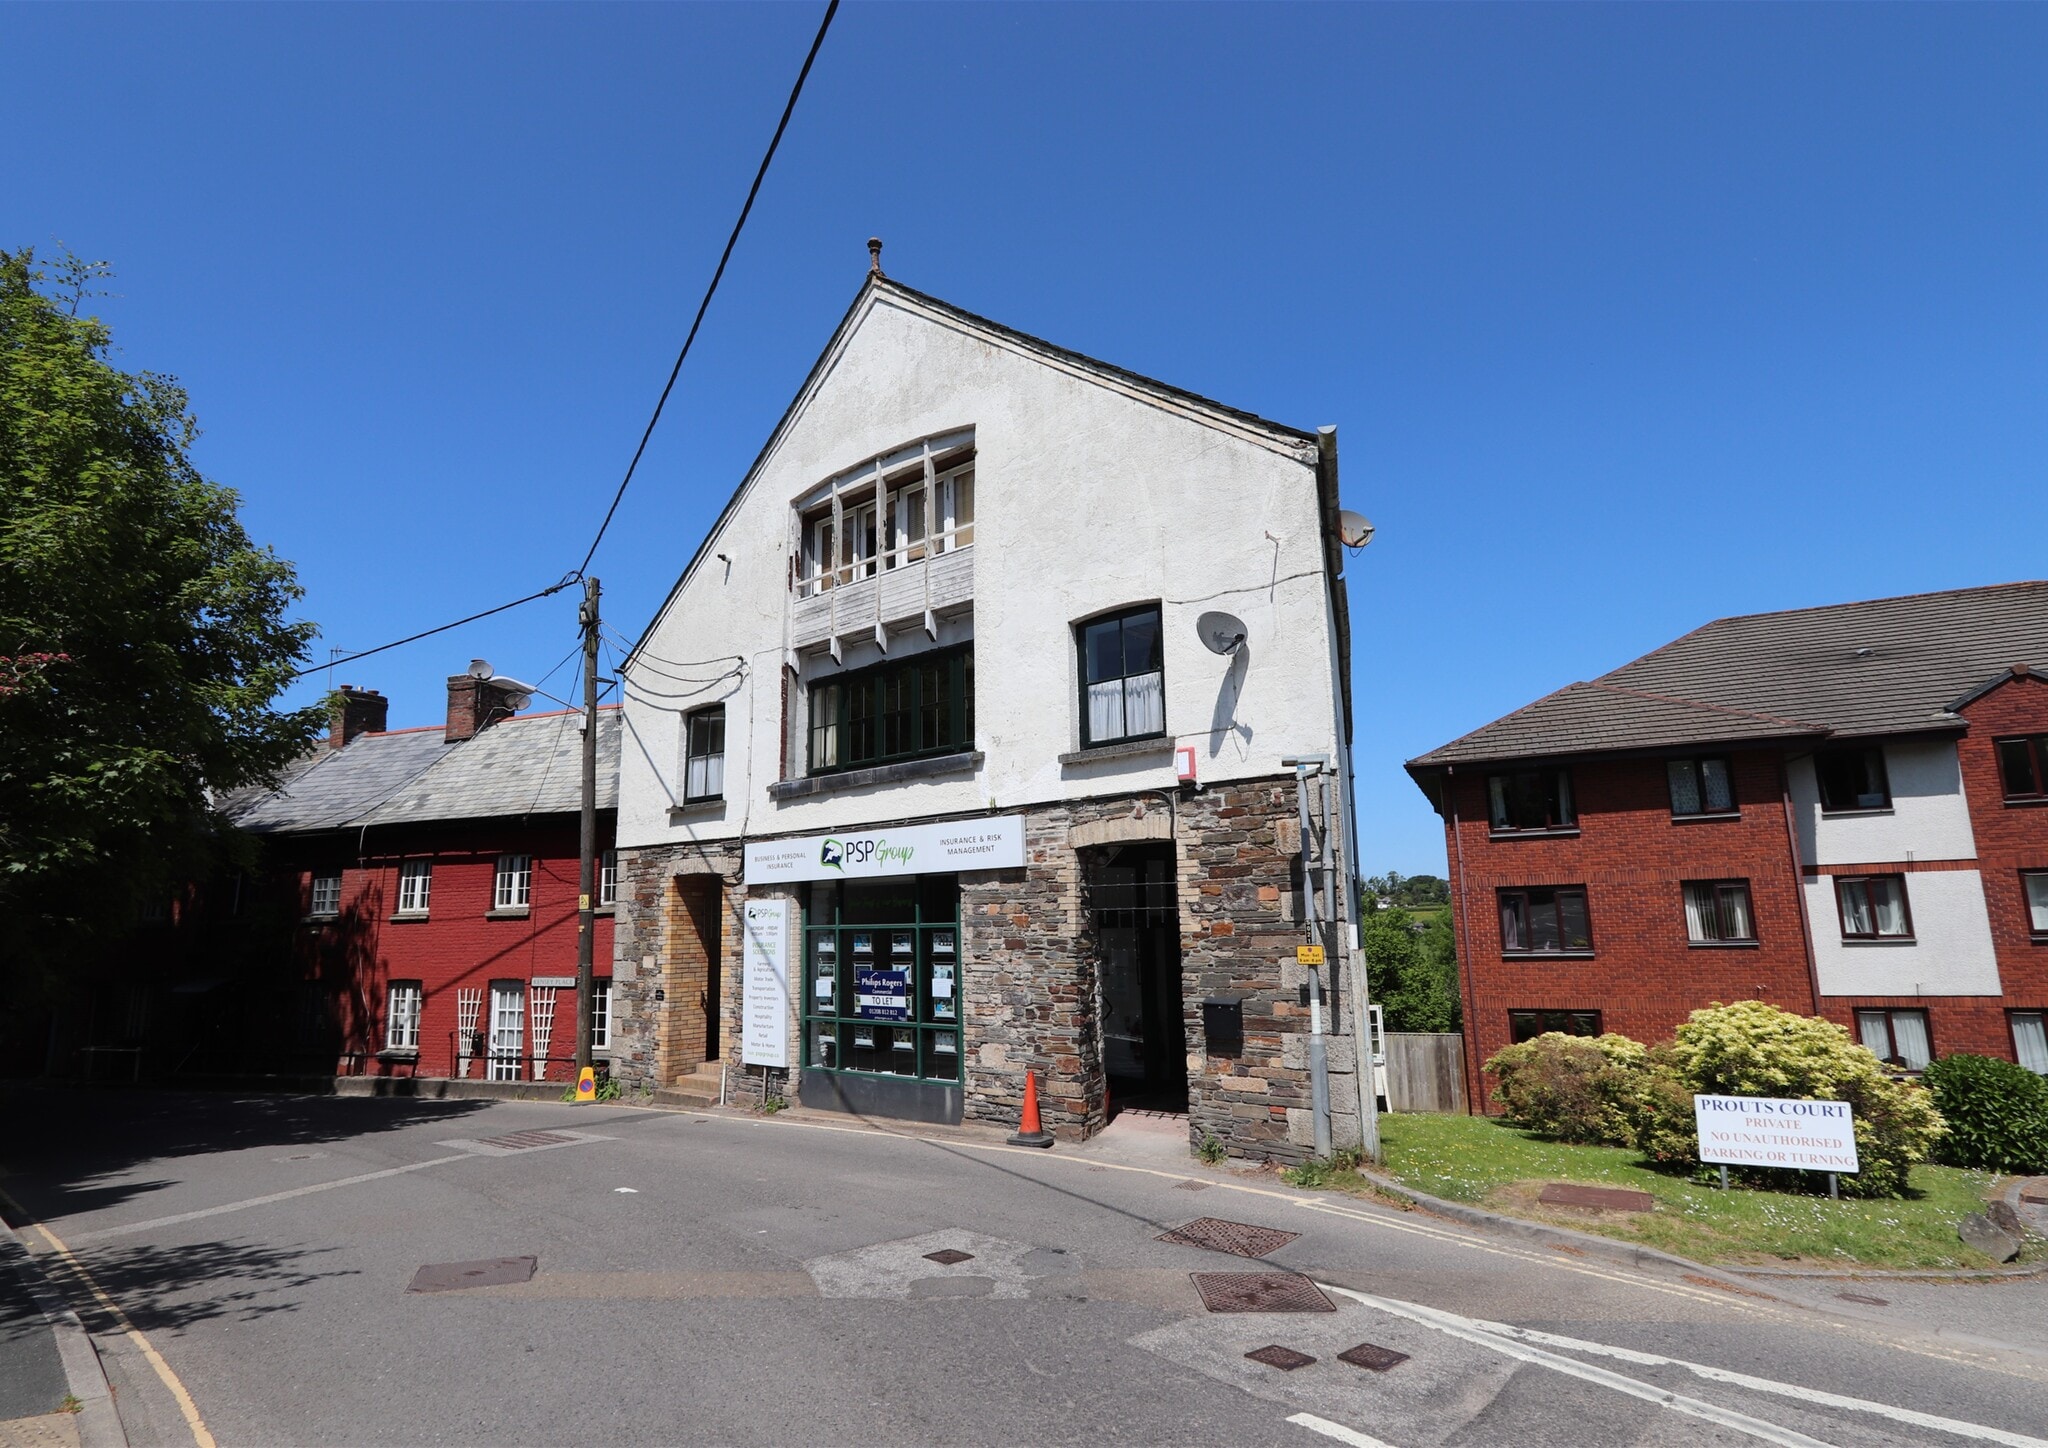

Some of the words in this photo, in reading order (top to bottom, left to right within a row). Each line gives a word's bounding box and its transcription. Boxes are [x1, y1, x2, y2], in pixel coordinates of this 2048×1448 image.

[940, 836, 977, 846] INSURANCE
[987, 834, 1002, 842] RISK
[845, 840, 875, 863] PSP
[875, 838, 914, 868] Group
[947, 845, 995, 855] MANAGEMENT
[754, 854, 776, 863] BUSINESS
[776, 853, 781, 861] &
[781, 852, 807, 860] PERSONAL
[766, 862, 794, 870] INSURANCE
[757, 908, 768, 918] PSP
[881, 978, 903, 989] Rogers
[871, 996, 881, 1005] TO
[882, 997, 893, 1006] LET
[1701, 1099, 1774, 1114] PROUTS
[1779, 1102, 1847, 1118] COURT
[1745, 1117, 1802, 1130] PRIVATE
[1711, 1131, 1730, 1142] NO
[1733, 1132, 1842, 1149] UNAUTHORISED
[1703, 1147, 1763, 1161] PARKING
[1766, 1151, 1787, 1162] OR
[1789, 1152, 1855, 1167] TURNING
